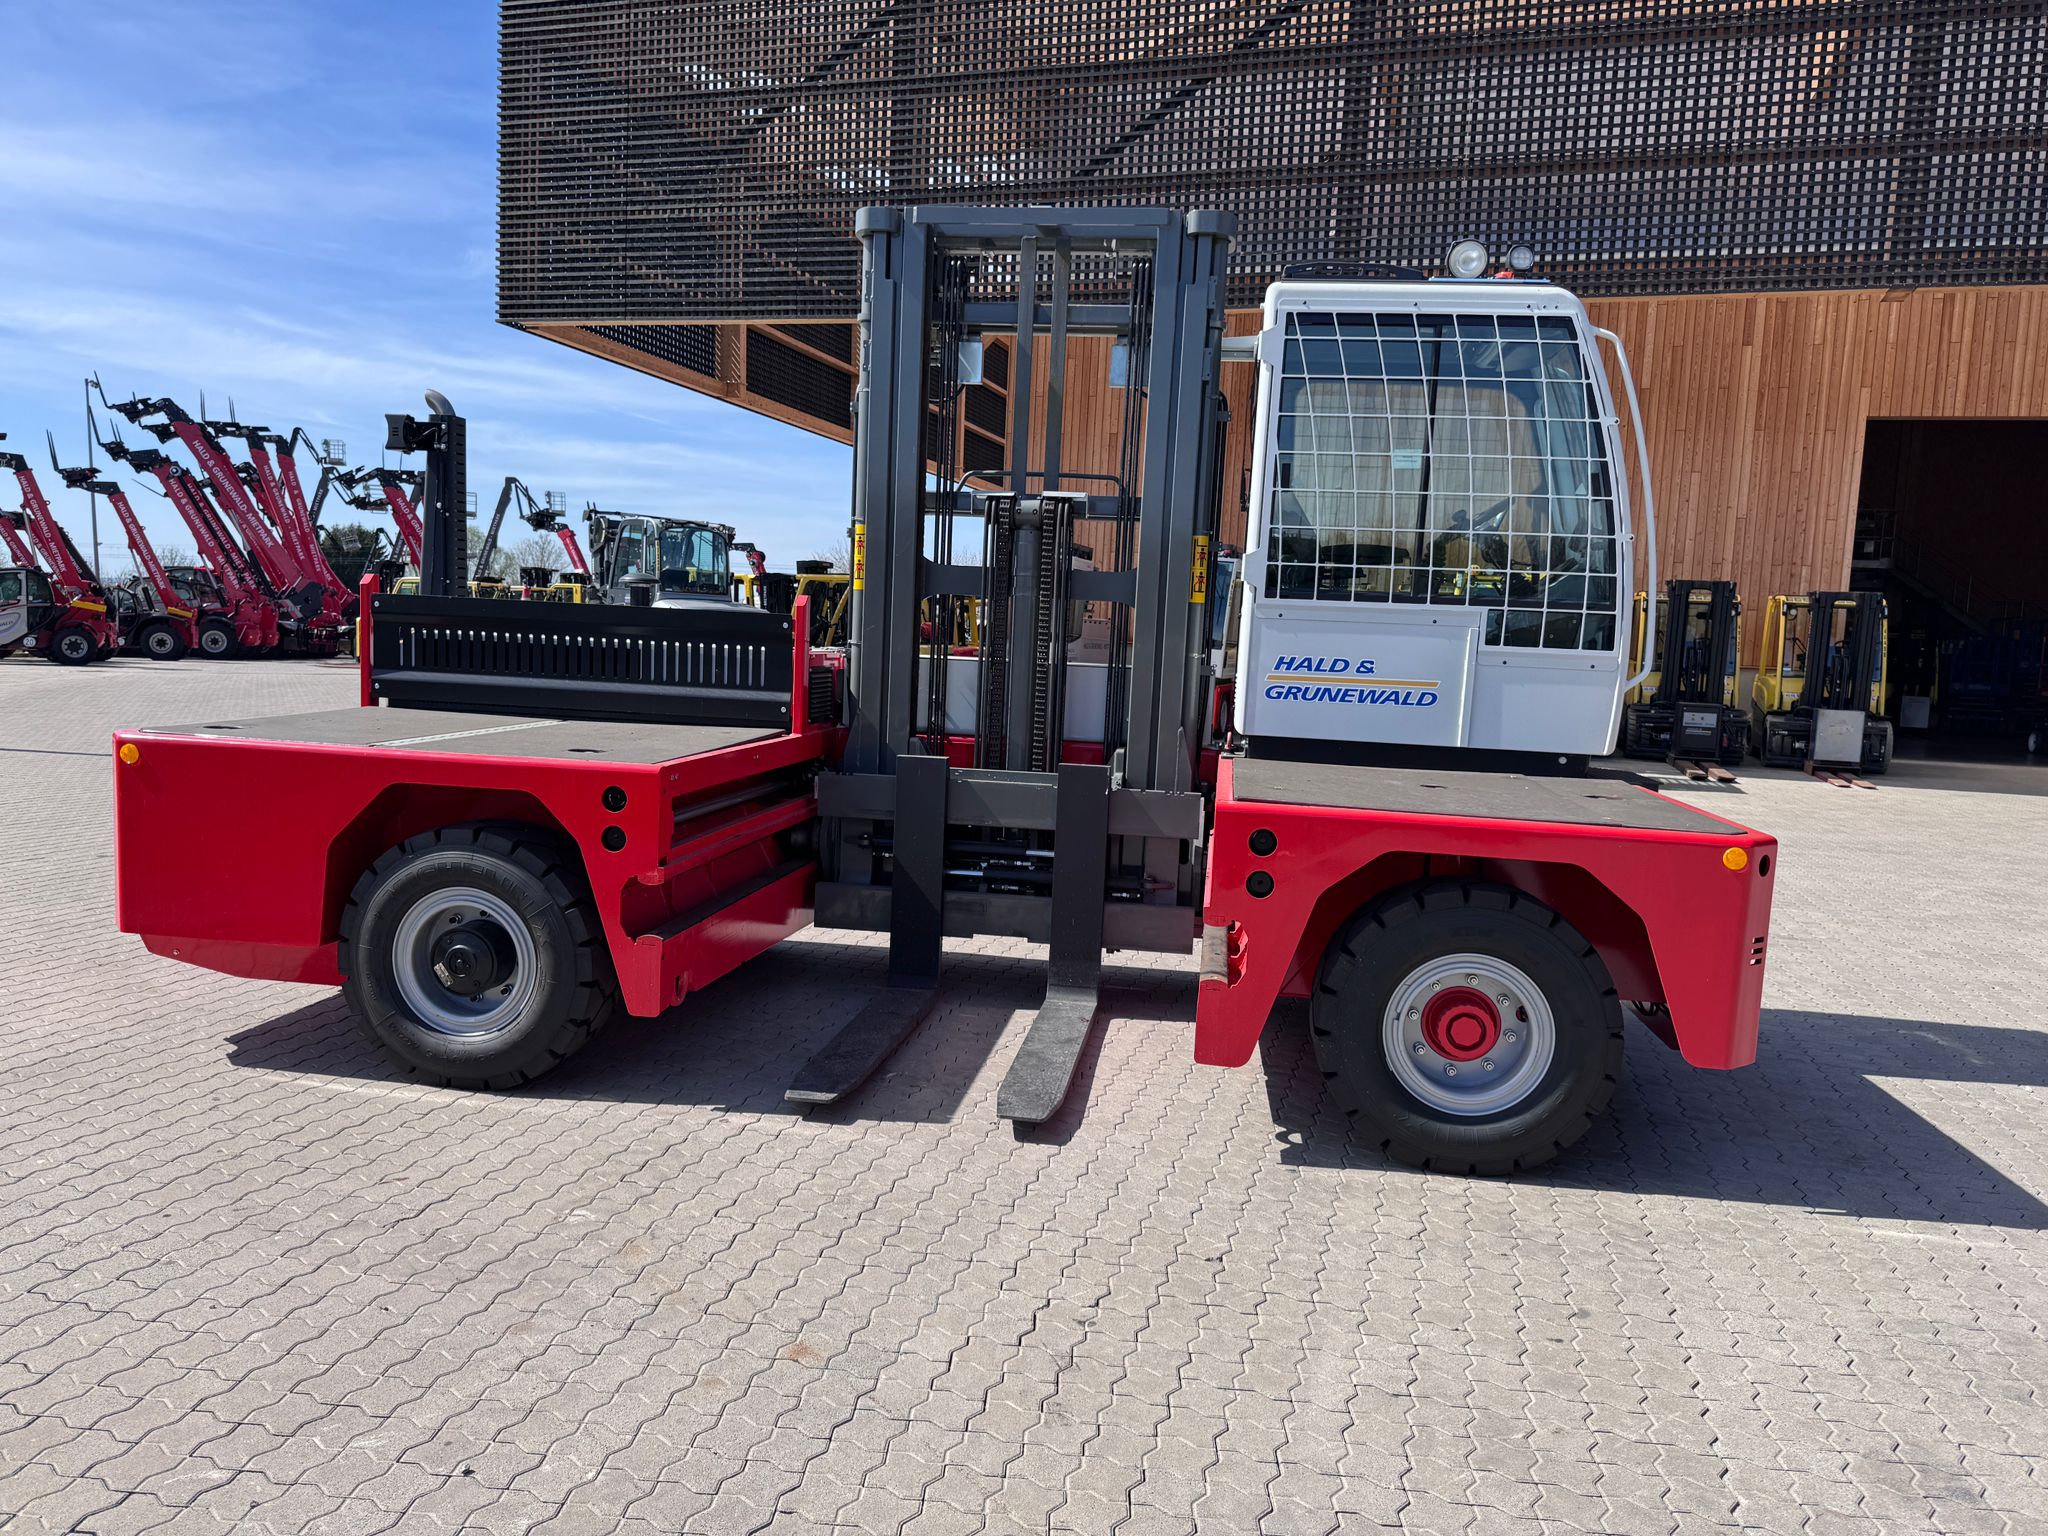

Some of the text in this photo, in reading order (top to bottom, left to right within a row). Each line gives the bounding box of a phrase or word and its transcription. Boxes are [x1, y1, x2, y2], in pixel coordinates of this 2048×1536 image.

[117, 502, 130, 519] HALD
[169, 478, 184, 498] HALD
[181, 497, 188, 505] &
[185, 504, 215, 548] GRUNEWALD
[193, 440, 210, 461] HALD
[207, 459, 215, 467] &
[246, 513, 275, 548] MIETPARK
[263, 465, 274, 481] HALD
[273, 488, 291, 524] GRUNEWALD
[289, 531, 306, 561] MIETPARK
[396, 498, 410, 513] HALD
[19, 476, 31, 491] HALD
[30, 500, 51, 538] GRUNEWALD
[49, 542, 66, 573] MIETPARK
[288, 471, 297, 486] HALD
[296, 499, 310, 533] GRUNEWALD
[309, 544, 322, 572] MIETPARK
[25, 638, 34, 646] 20
[1273, 655, 1376, 674] HALD &
[1264, 684, 1439, 707] GRUNEWALD
